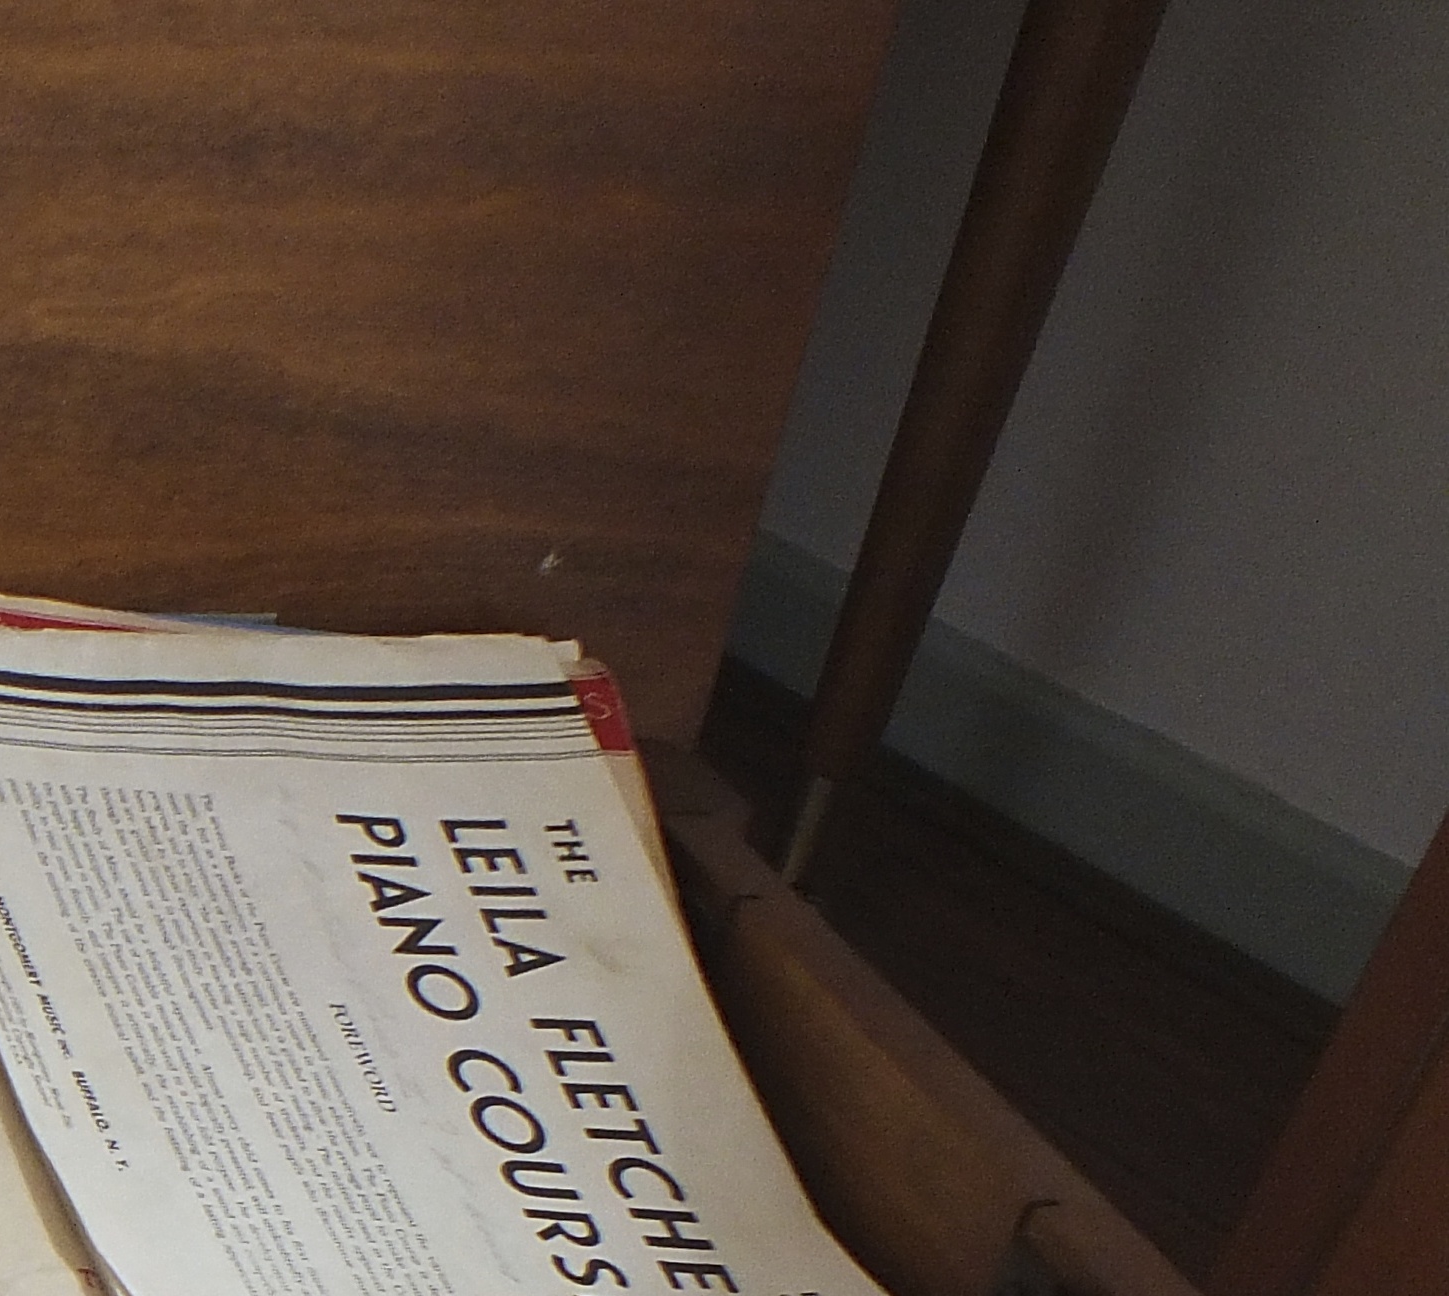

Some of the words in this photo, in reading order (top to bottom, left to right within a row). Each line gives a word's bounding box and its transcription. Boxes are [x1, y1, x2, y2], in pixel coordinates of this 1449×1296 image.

[439, 819, 567, 977] LEILA
[543, 818, 599, 884] THE
[335, 813, 480, 1021] PIANO
[37, 993, 66, 1035] MUSIC
[328, 1002, 398, 1114] FOREWORD
